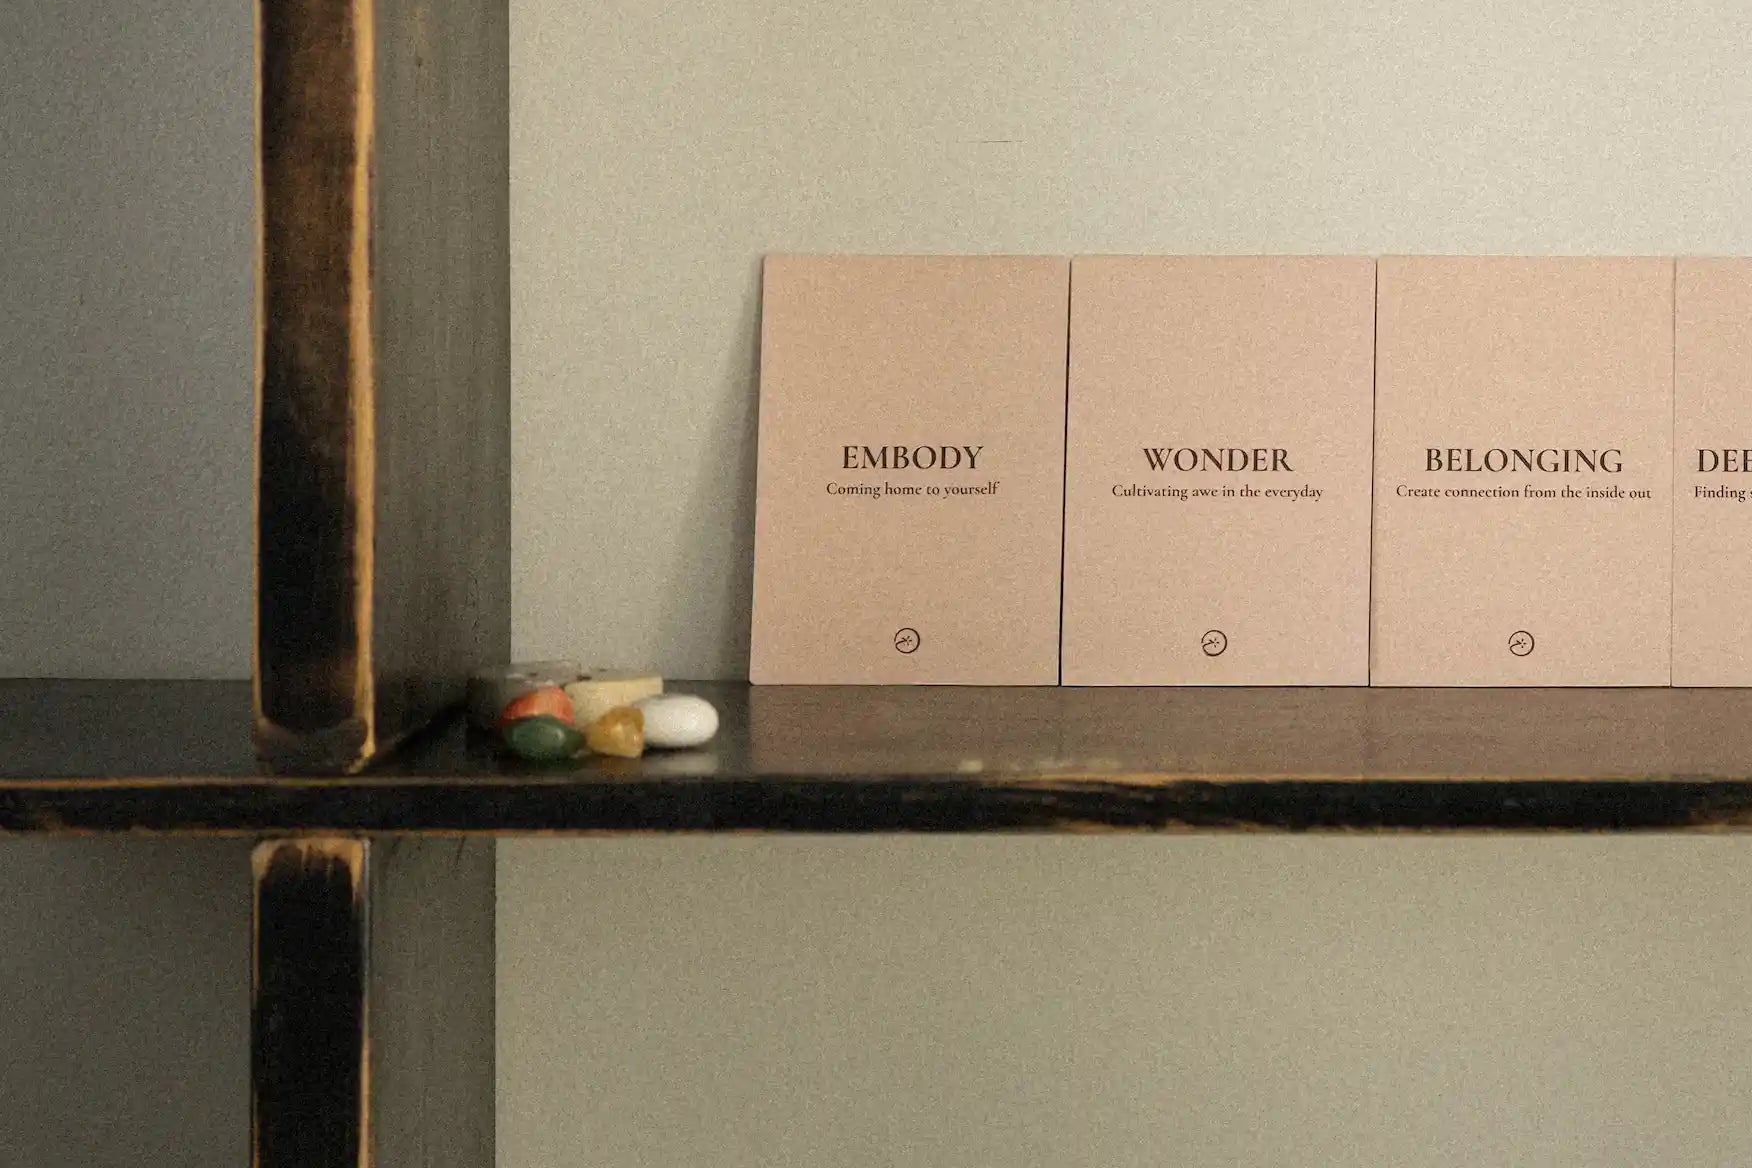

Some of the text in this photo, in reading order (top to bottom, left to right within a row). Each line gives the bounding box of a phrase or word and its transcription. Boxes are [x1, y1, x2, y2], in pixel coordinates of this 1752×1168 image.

[842, 445, 985, 470] EMBODY
[1142, 447, 1295, 472] WONDER
[1424, 447, 1623, 474] BELONGING
[826, 480, 1001, 500] Coming home to yourself
[1111, 483, 1324, 503] Cultivating awe in the everyday
[1396, 484, 1652, 499] Create connection from the inside out
[1694, 484, 1747, 503] Finding
